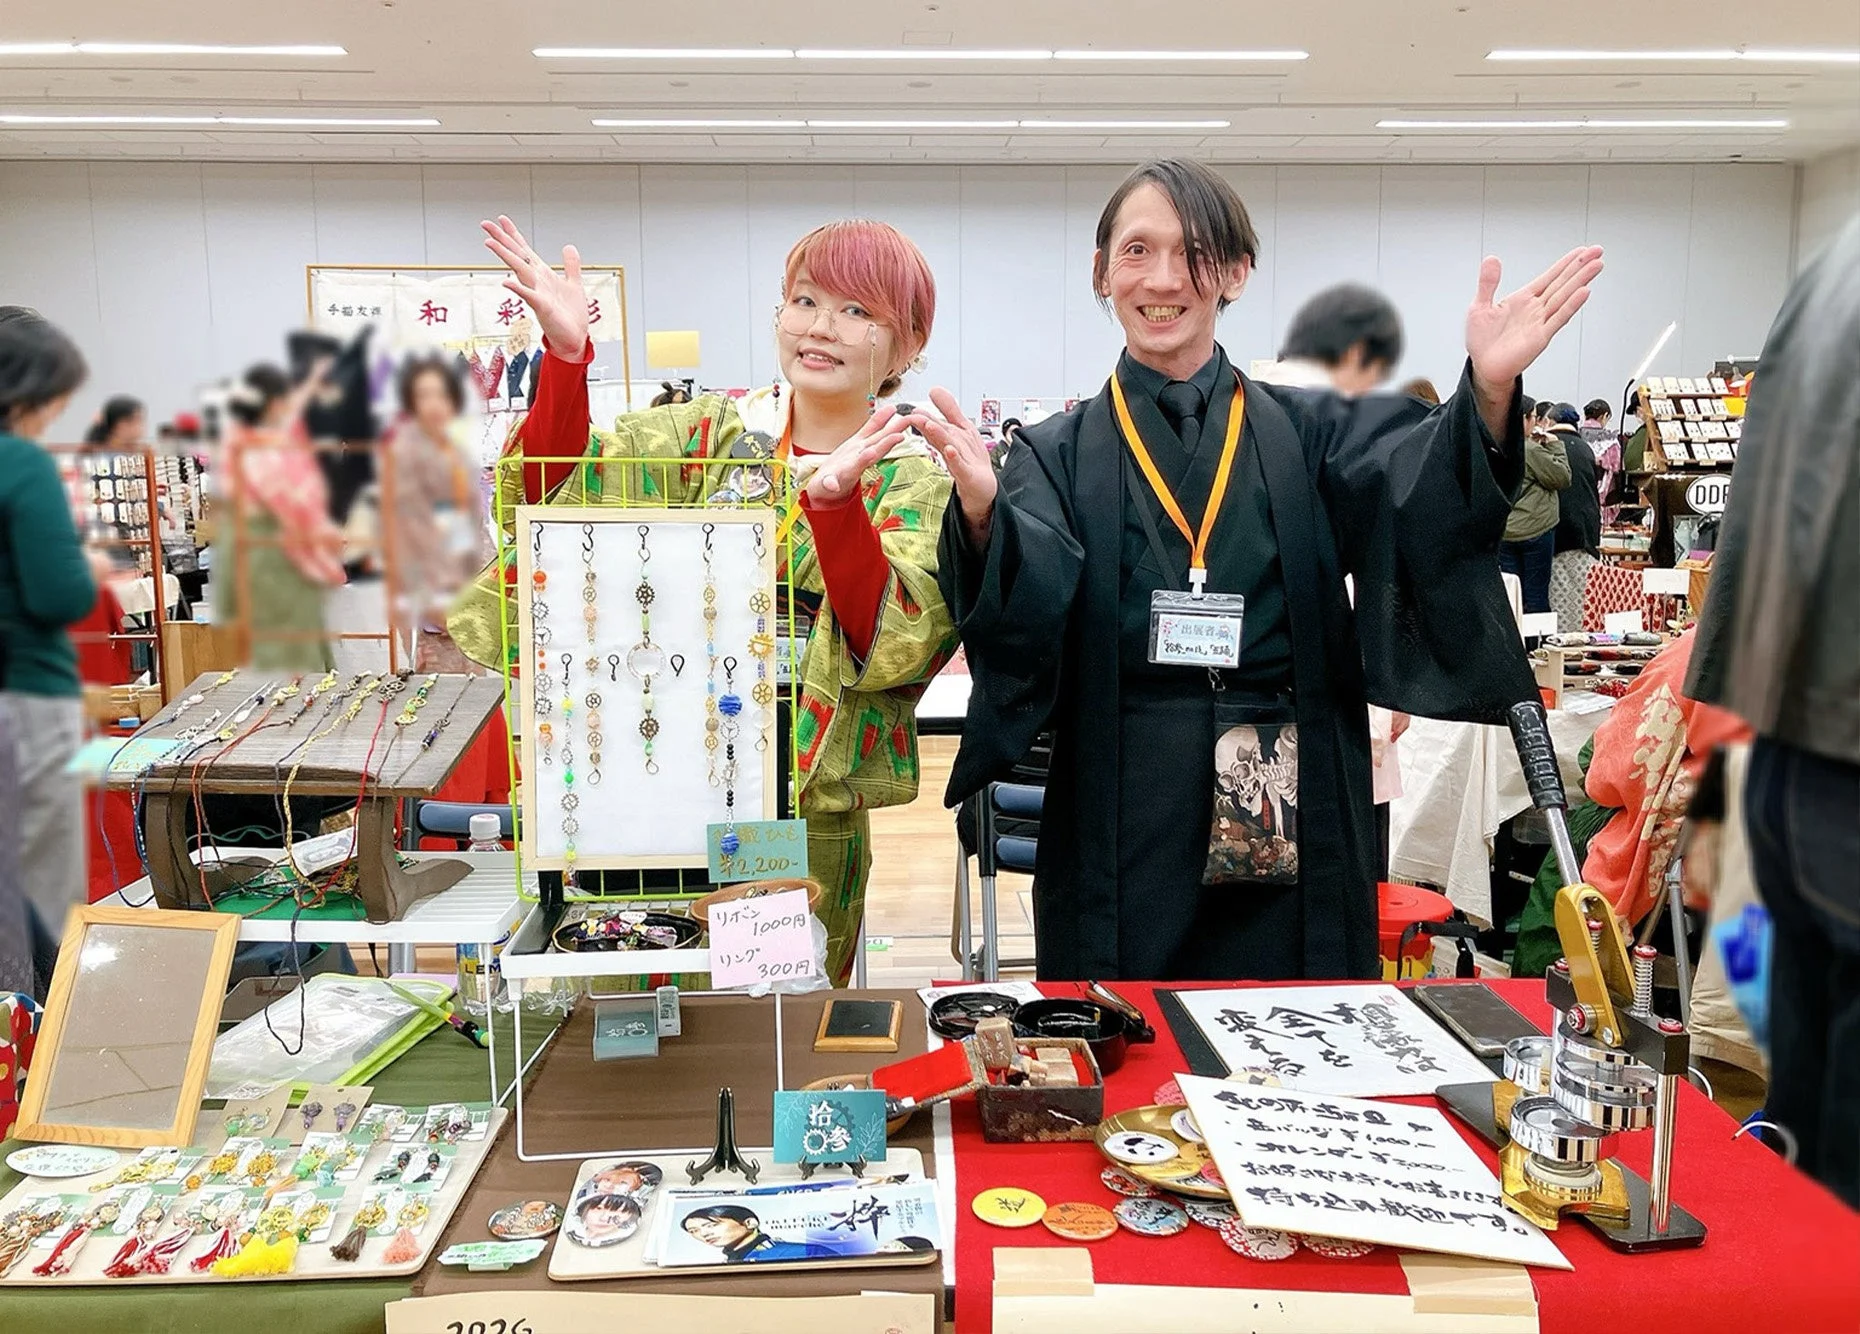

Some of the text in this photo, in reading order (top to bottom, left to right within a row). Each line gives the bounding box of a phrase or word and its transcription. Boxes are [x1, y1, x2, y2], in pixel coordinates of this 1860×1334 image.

[716, 905, 761, 927] リボン
[719, 947, 762, 968] リング
[757, 959, 811, 979] 300円
